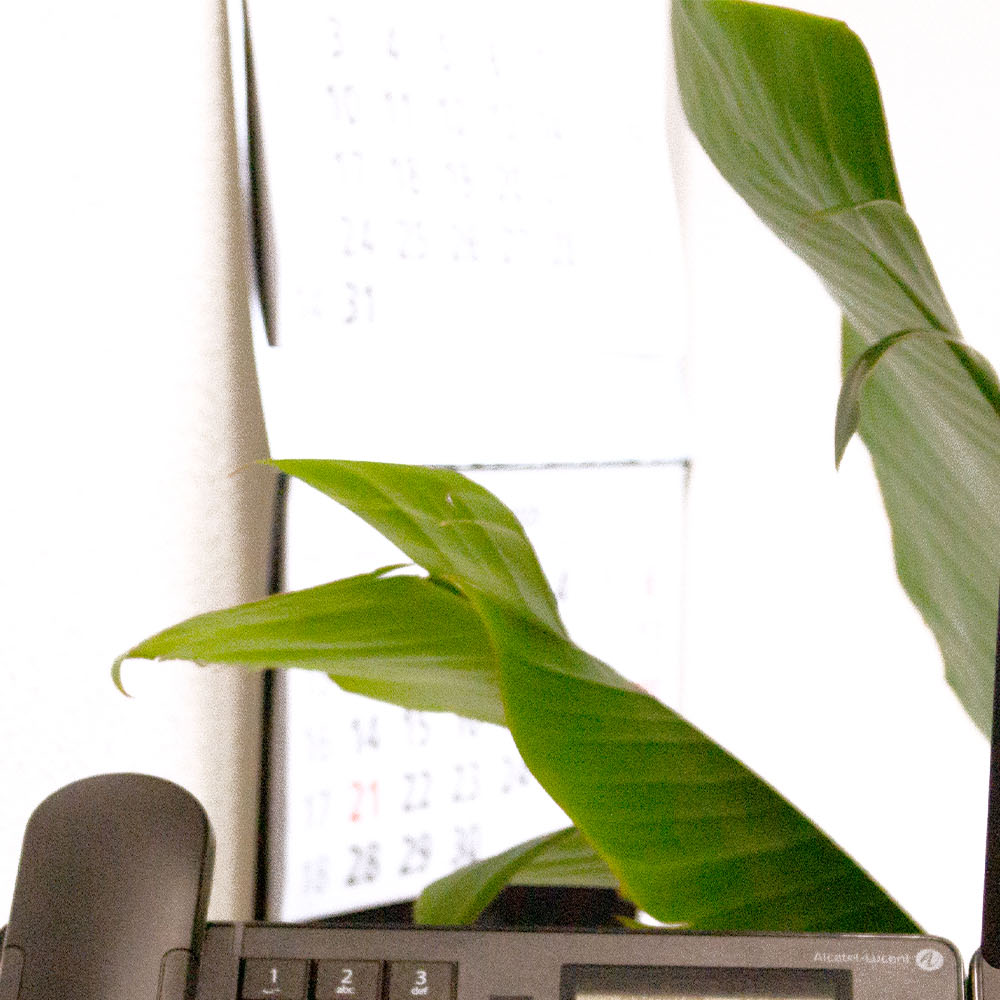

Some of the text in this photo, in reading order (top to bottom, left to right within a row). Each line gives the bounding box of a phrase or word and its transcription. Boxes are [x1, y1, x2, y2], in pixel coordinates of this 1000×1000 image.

[349, 780, 380, 823] 21
[402, 770, 432, 812] 22
[345, 841, 381, 888] 28
[397, 832, 432, 877] 29
[271, 968, 278, 983] 1
[341, 968, 353, 984] 2
[416, 970, 427, 986] 3
[335, 985, 354, 994] abc
[411, 986, 428, 996] def
